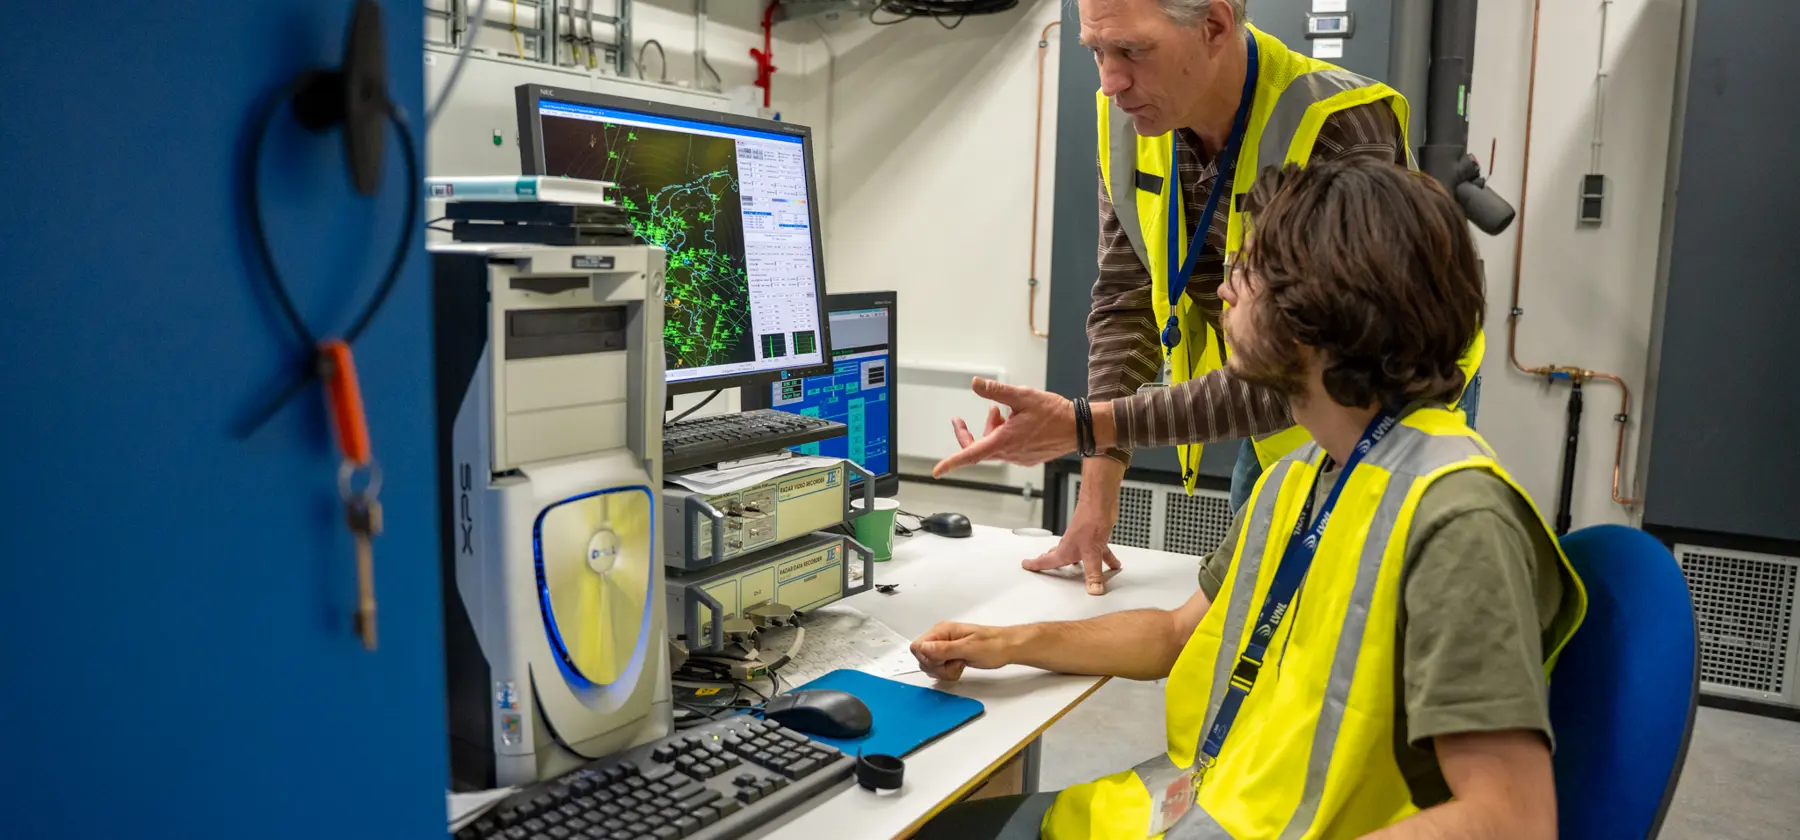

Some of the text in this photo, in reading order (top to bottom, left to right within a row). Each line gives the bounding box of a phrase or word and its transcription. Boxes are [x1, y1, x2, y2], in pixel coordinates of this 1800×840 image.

[540, 88, 554, 96] NEC
[1372, 415, 1395, 440] LVNL
[780, 485, 794, 493] RADAR
[806, 477, 825, 488] RECORDER
[779, 556, 823, 575] RADAR DATA RECORDER
[1269, 602, 1288, 625] LVNL
